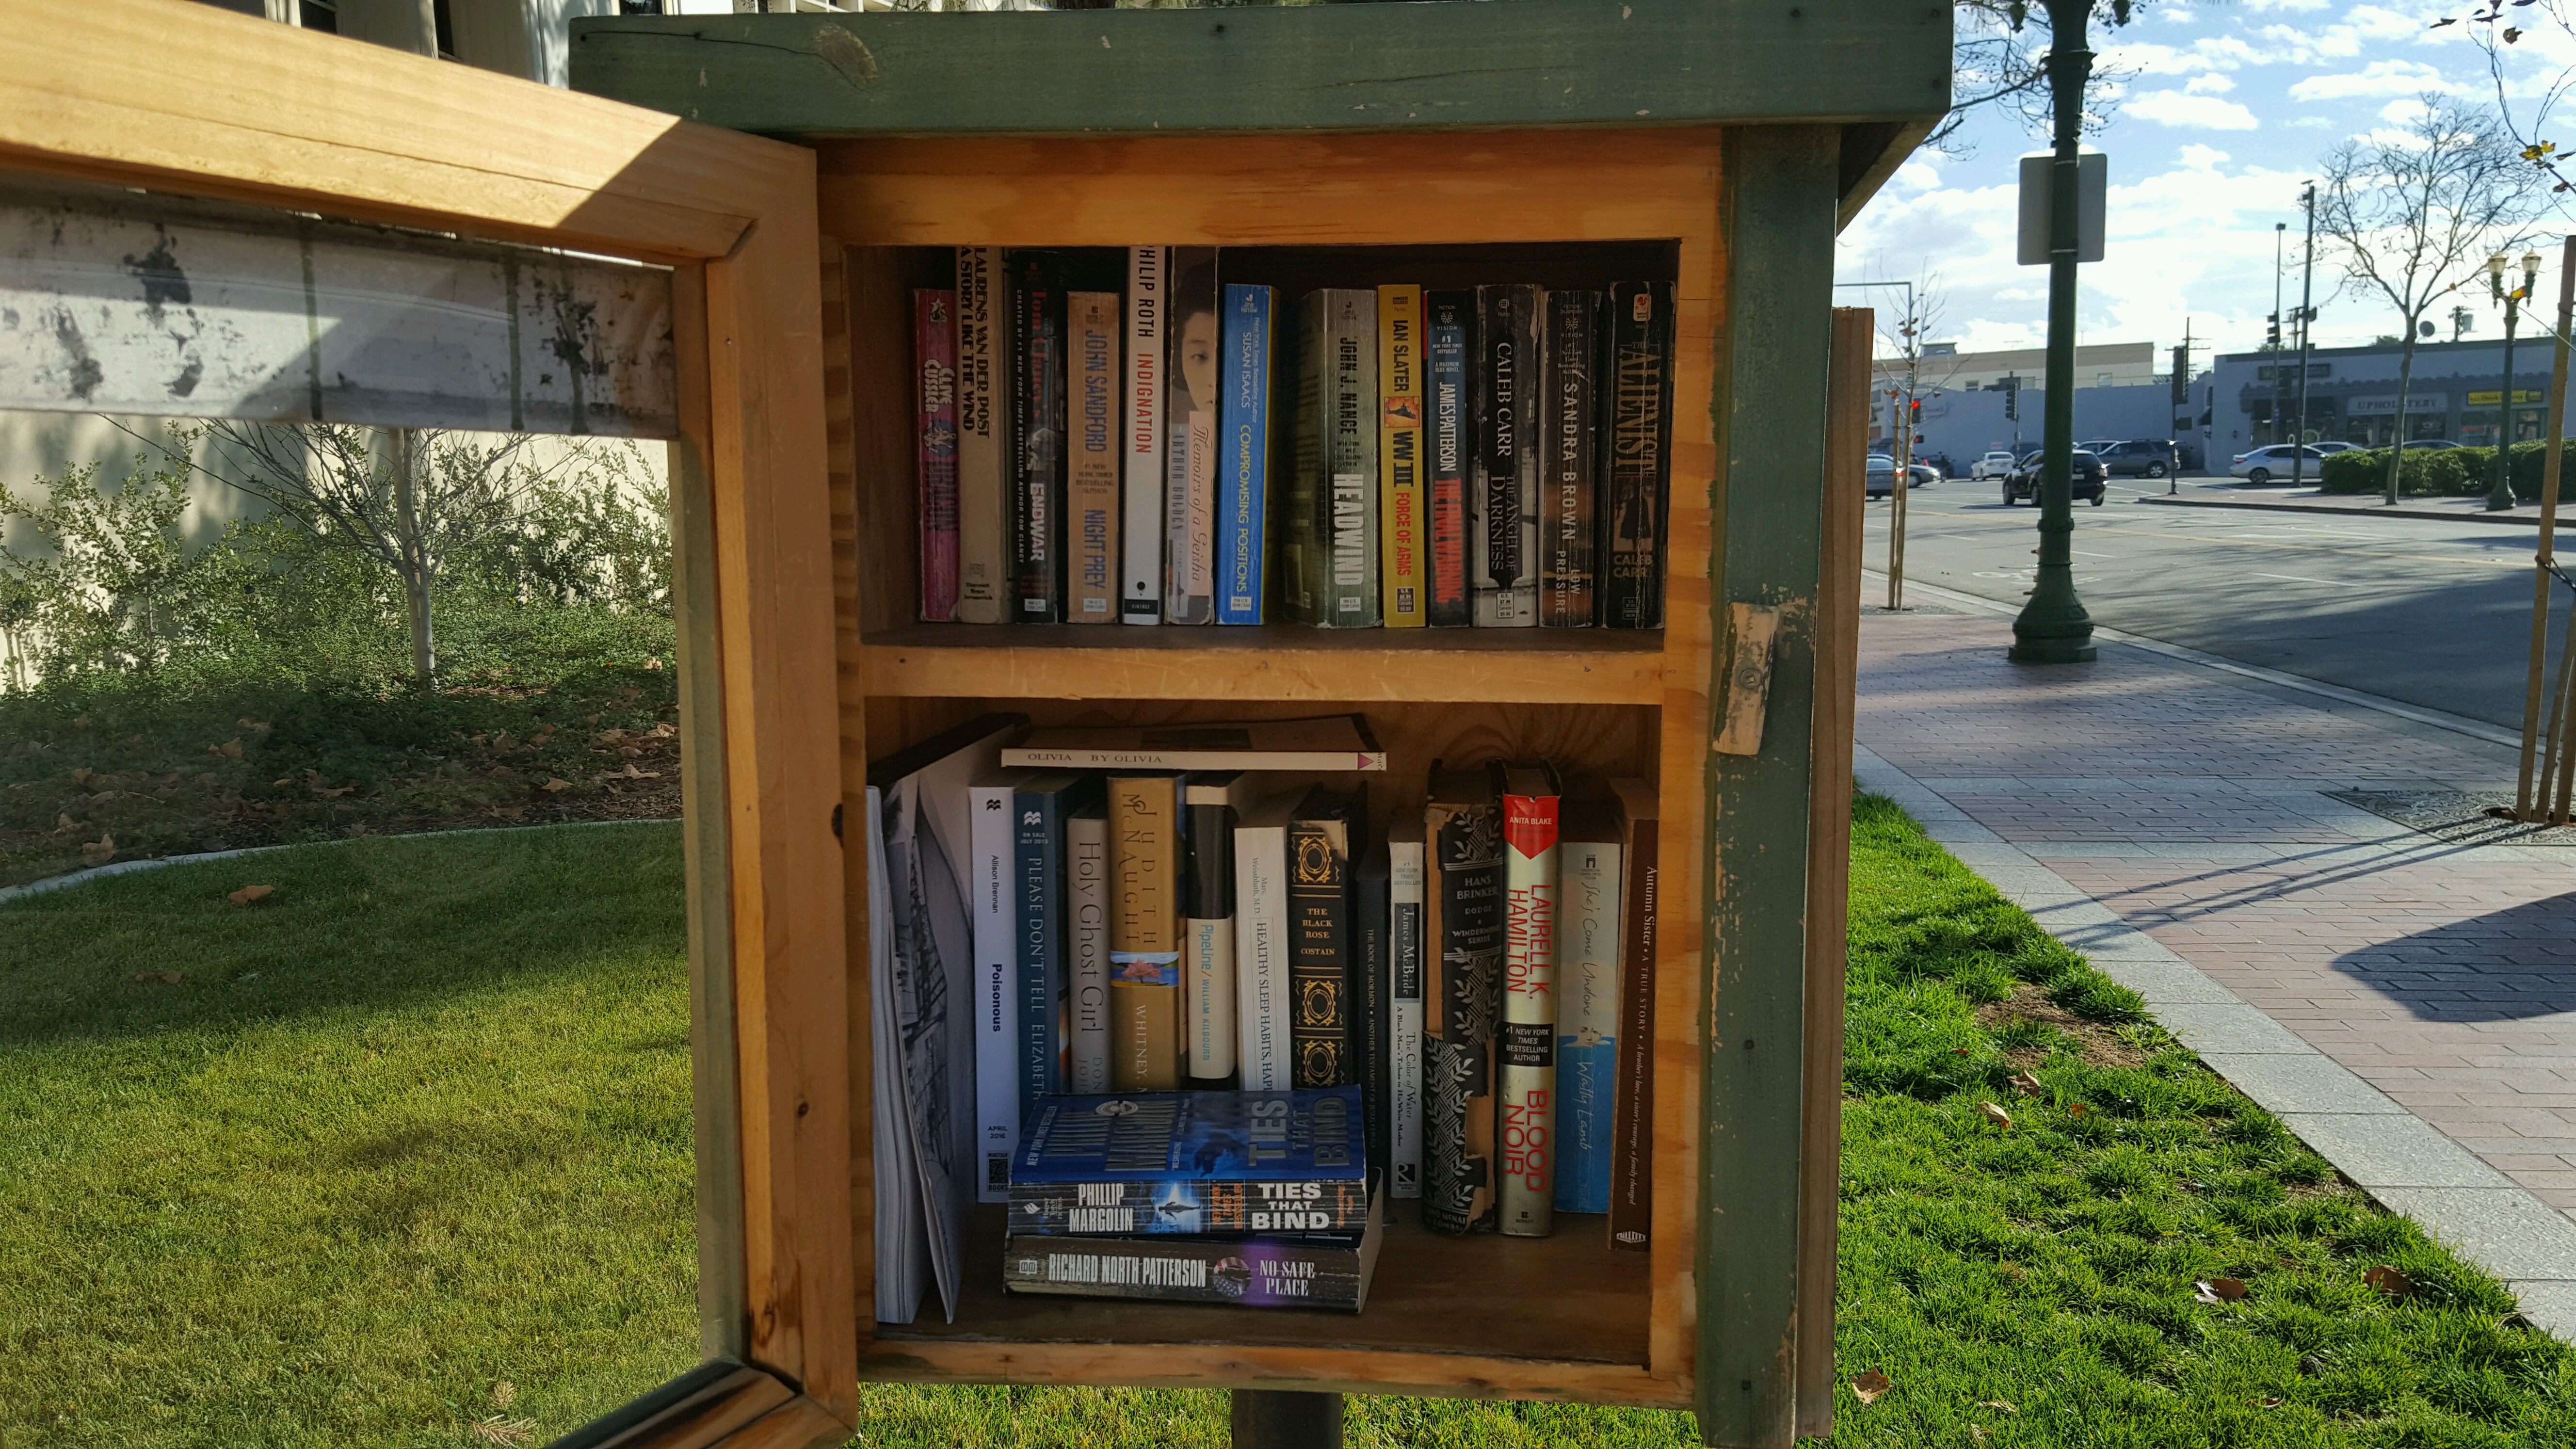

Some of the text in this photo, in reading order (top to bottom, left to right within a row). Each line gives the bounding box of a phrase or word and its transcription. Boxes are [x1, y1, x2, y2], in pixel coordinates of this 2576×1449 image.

[1138, 299, 1155, 338] ROTH
[1393, 320, 1409, 341] IAN
[961, 247, 975, 431] A STORY LIKE THE WIND
[975, 248, 990, 438] LAURENS VAN DER POST
[1084, 329, 1108, 372] JOHN
[1340, 337, 1357, 371] JOHN
[924, 359, 941, 415] CUSSLER
[939, 367, 955, 405] CLIVE
[1241, 331, 1252, 409] SUSAN ISAACS
[1340, 376, 1357, 388] J.
[1393, 345, 1410, 392] SLATER
[1084, 375, 1108, 452] SANDFORD
[1135, 354, 1154, 453] INDIGNATION
[1340, 393, 1357, 435] NANCE
[1497, 342, 1513, 457] CALEB CARR
[1615, 347, 1662, 471] ALIENIST
[2358, 399, 2437, 410] UPHOLTERY
[1393, 431, 1414, 461] WW
[1439, 381, 1457, 472] JAMES PATTERSON
[1172, 435, 1185, 480] ARTHUR
[1238, 424, 1252, 524] COMPROMISING
[1562, 383, 1578, 540] SANDRA BROWN
[1030, 483, 1045, 561] ENDWAR
[1172, 487, 1184, 530] GOLDEN
[1189, 425, 1209, 581] Memoirs of a Geisha
[1396, 492, 1411, 528] FORCE
[1084, 510, 1107, 553] NIGHT
[1334, 473, 1364, 586] HEADWIND
[1396, 529, 1412, 544] OF
[1491, 475, 1506, 571] DARKNESS
[1506, 476, 1519, 571] THE ANGEL OF
[1084, 555, 1107, 589] PREY
[1236, 528, 1249, 593] POSITIONS
[1397, 546, 1412, 577] ARMS
[1613, 554, 1653, 566] CALEB
[1613, 567, 1648, 579] CARR
[1555, 550, 1567, 614] PRESSURE
[1570, 569, 1581, 596] LOW
[1028, 753, 1163, 764] OLIVIA BY OLIVIA
[1509, 816, 1530, 825] ANITA
[991, 854, 1000, 914] Allison Brennan
[1133, 800, 1157, 944] JUDITH
[1465, 875, 1492, 887] HANS
[1643, 866, 1658, 912] Autumn
[1253, 898, 1261, 915] M.D.
[1306, 907, 1328, 916] THE
[1456, 886, 1498, 901] BRINKER
[1465, 904, 1492, 915] DODGE
[1580, 881, 1601, 913] She's
[1028, 857, 1046, 1013] PLEASE DON'T TELL
[1073, 842, 1104, 1032] Holy Ghost Girl
[1302, 919, 1334, 927] BLACK
[1305, 931, 1331, 939] ROSE
[1506, 889, 1529, 993] HAMILTON
[1529, 884, 1552, 1000] LAURELL K.
[1582, 918, 1598, 955] Come
[1642, 915, 1656, 946] Sister
[1300, 948, 1336, 956] COSTAIN
[1402, 908, 1415, 996] James McBride
[992, 963, 1003, 1032] Poisonous
[1256, 922, 1272, 1061] HEALTHY SLEEP HABITS,
[1581, 962, 1598, 1017] Undone
[1640, 966, 1648, 994] TRUE
[1202, 979, 1211, 1061] WILLIAM KILBOURN
[1514, 1027, 1530, 1035] NEW
[1637, 998, 1647, 1036] STORY
[1135, 1004, 1148, 1080] WHITNEY,
[1505, 1044, 1548, 1053] BESTSELLING
[1513, 1053, 1541, 1062] AUTHOR
[1403, 1032, 1416, 1119] The Color of Water
[1636, 1051, 1644, 1079] brother's
[1572, 1062, 1594, 1150] Wally Lamb
[1248, 1099, 1289, 1167] TIES
[1292, 1110, 1310, 1150] THAT
[1314, 1095, 1351, 1167] BIND
[1504, 1104, 1525, 1175] NOIR
[1526, 1090, 1549, 1192] BLOOD
[1027, 1152, 1040, 1166] NEW
[1628, 1155, 1639, 1177] family
[1078, 1183, 1125, 1207] PHILLIP
[1234, 1184, 1243, 1229] BESTSELLER
[1257, 1182, 1322, 1200] TIES
[1268, 1201, 1313, 1211] THAT
[1627, 1178, 1637, 1205] changed
[1069, 1208, 1134, 1232] MARGOLIN
[1212, 1208, 1221, 1224] NEW
[1251, 1212, 1330, 1230] BIND
[1048, 1253, 1207, 1288] RICHARD NORTH PATTERSON
[1259, 1260, 1315, 1279] NO SAFE
[1266, 1278, 1309, 1296] PLACE
